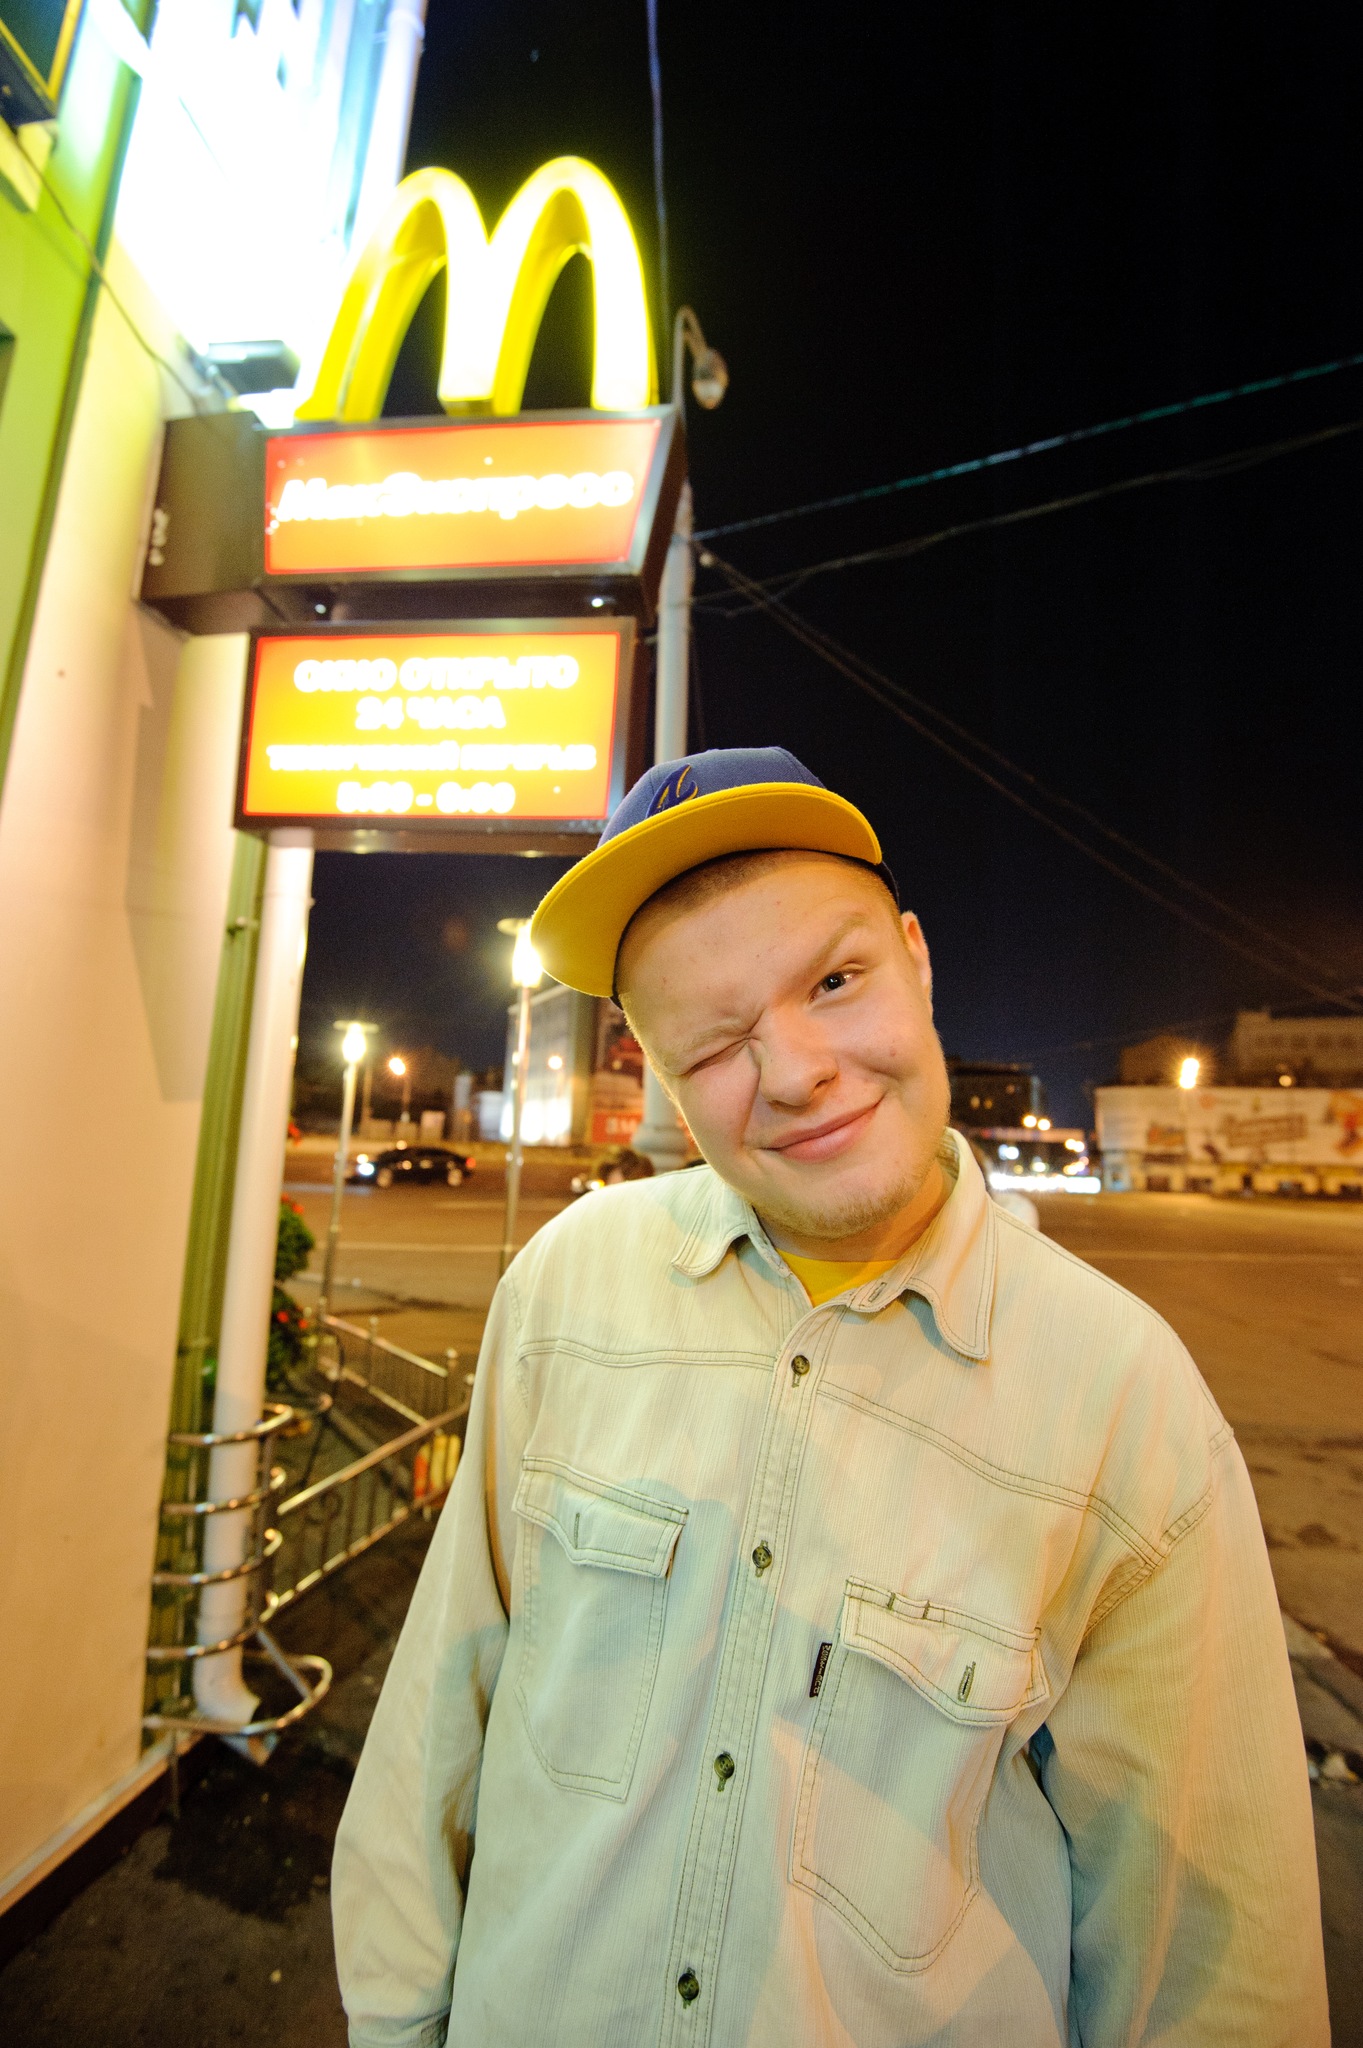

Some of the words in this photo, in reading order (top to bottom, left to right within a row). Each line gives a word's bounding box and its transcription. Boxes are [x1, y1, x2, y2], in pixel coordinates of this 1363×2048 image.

[293, 657, 398, 693] ОКНО
[399, 655, 580, 692] ОТКРЫТО
[355, 696, 405, 730] 24
[406, 695, 507, 730] ЧАСА
